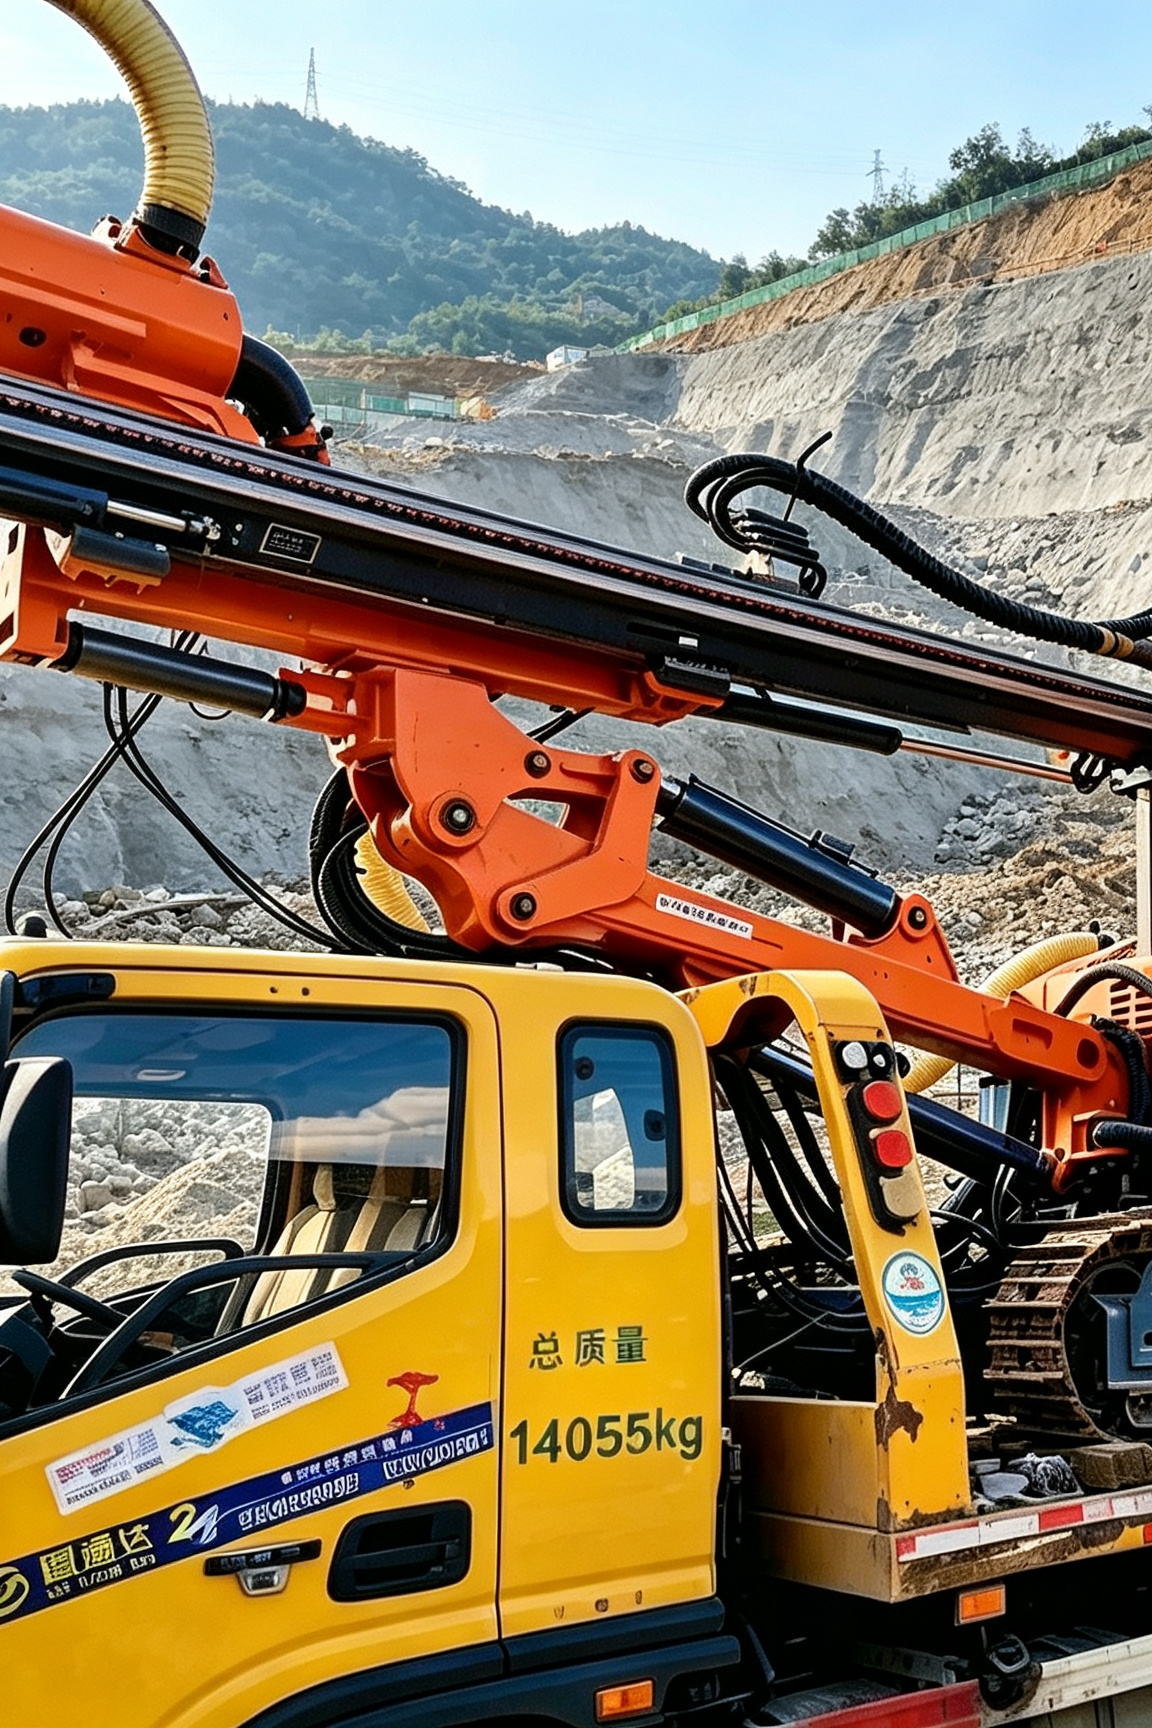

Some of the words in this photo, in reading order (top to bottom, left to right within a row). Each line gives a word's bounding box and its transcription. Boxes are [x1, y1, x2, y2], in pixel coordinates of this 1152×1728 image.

[529, 1326, 648, 1370] 总质量
[510, 1407, 703, 1465] 14055kg
